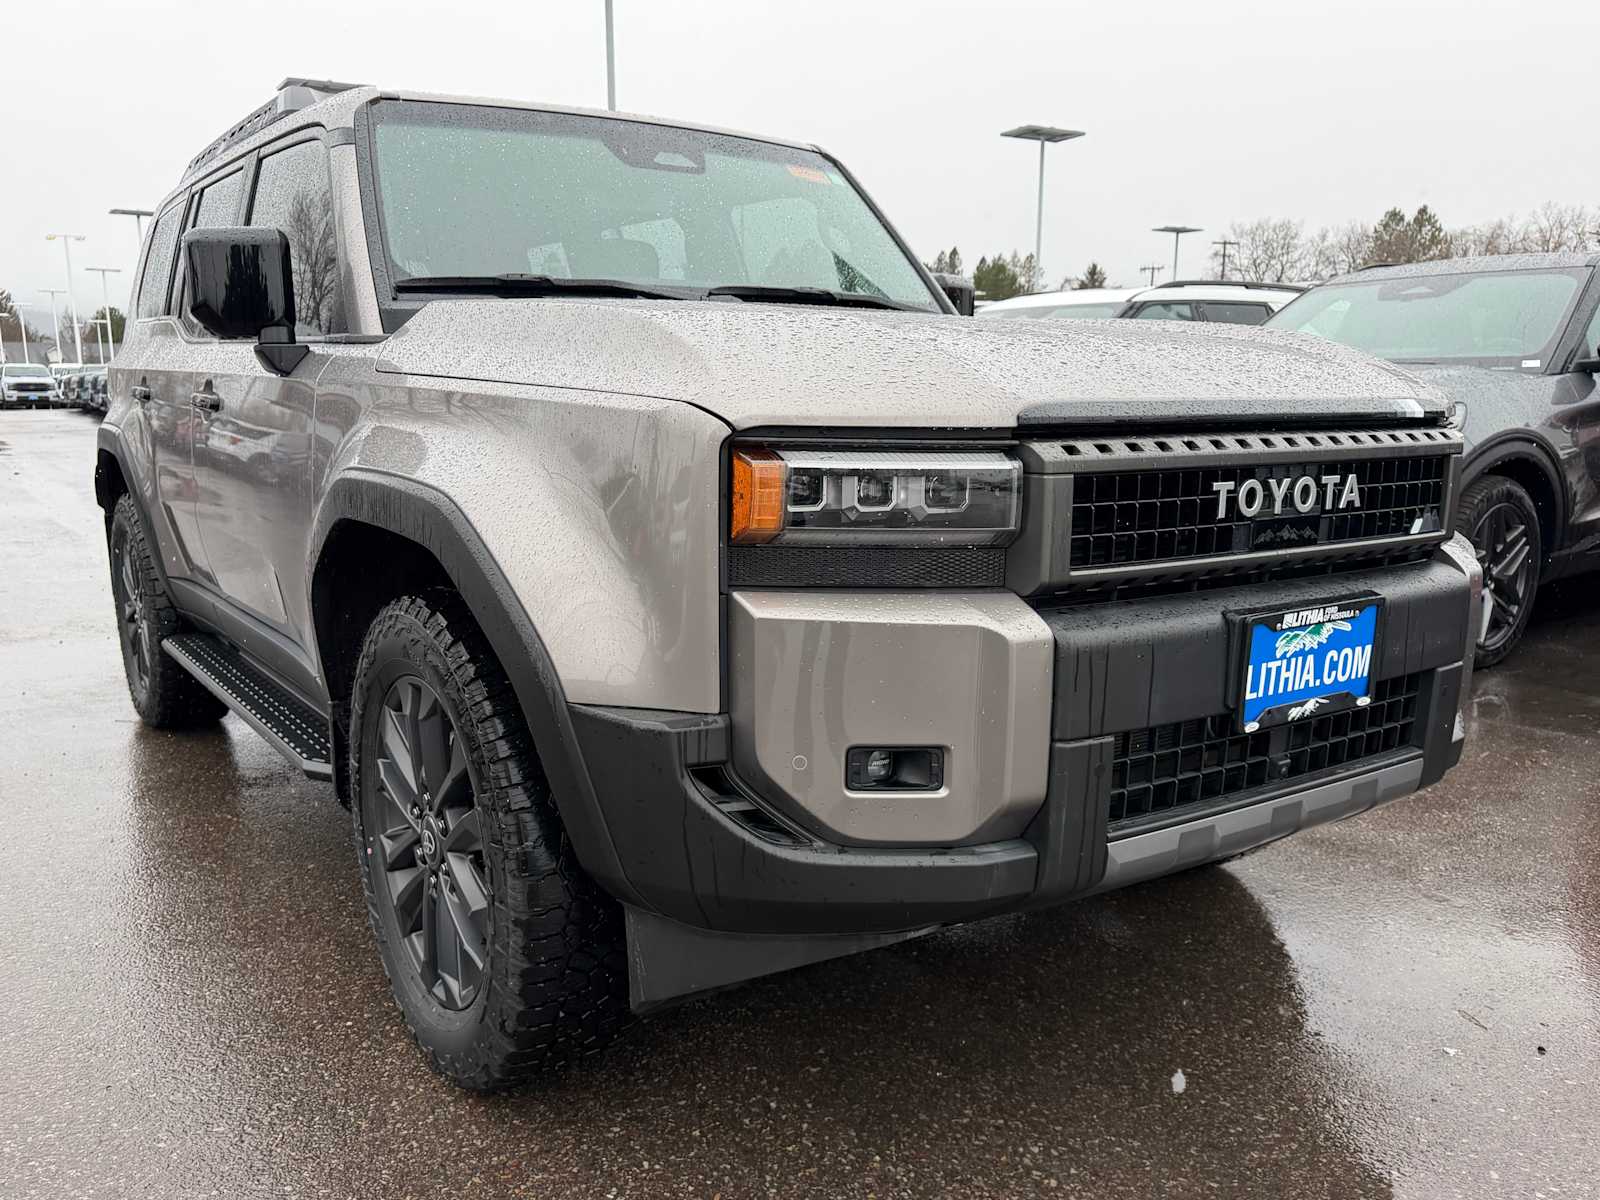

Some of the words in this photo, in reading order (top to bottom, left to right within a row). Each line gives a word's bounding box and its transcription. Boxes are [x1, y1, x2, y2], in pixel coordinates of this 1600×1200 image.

[1212, 473, 1361, 519] TOYOTA
[1292, 608, 1324, 626] LITHIA
[1245, 643, 1372, 700] LITHIA.COM
